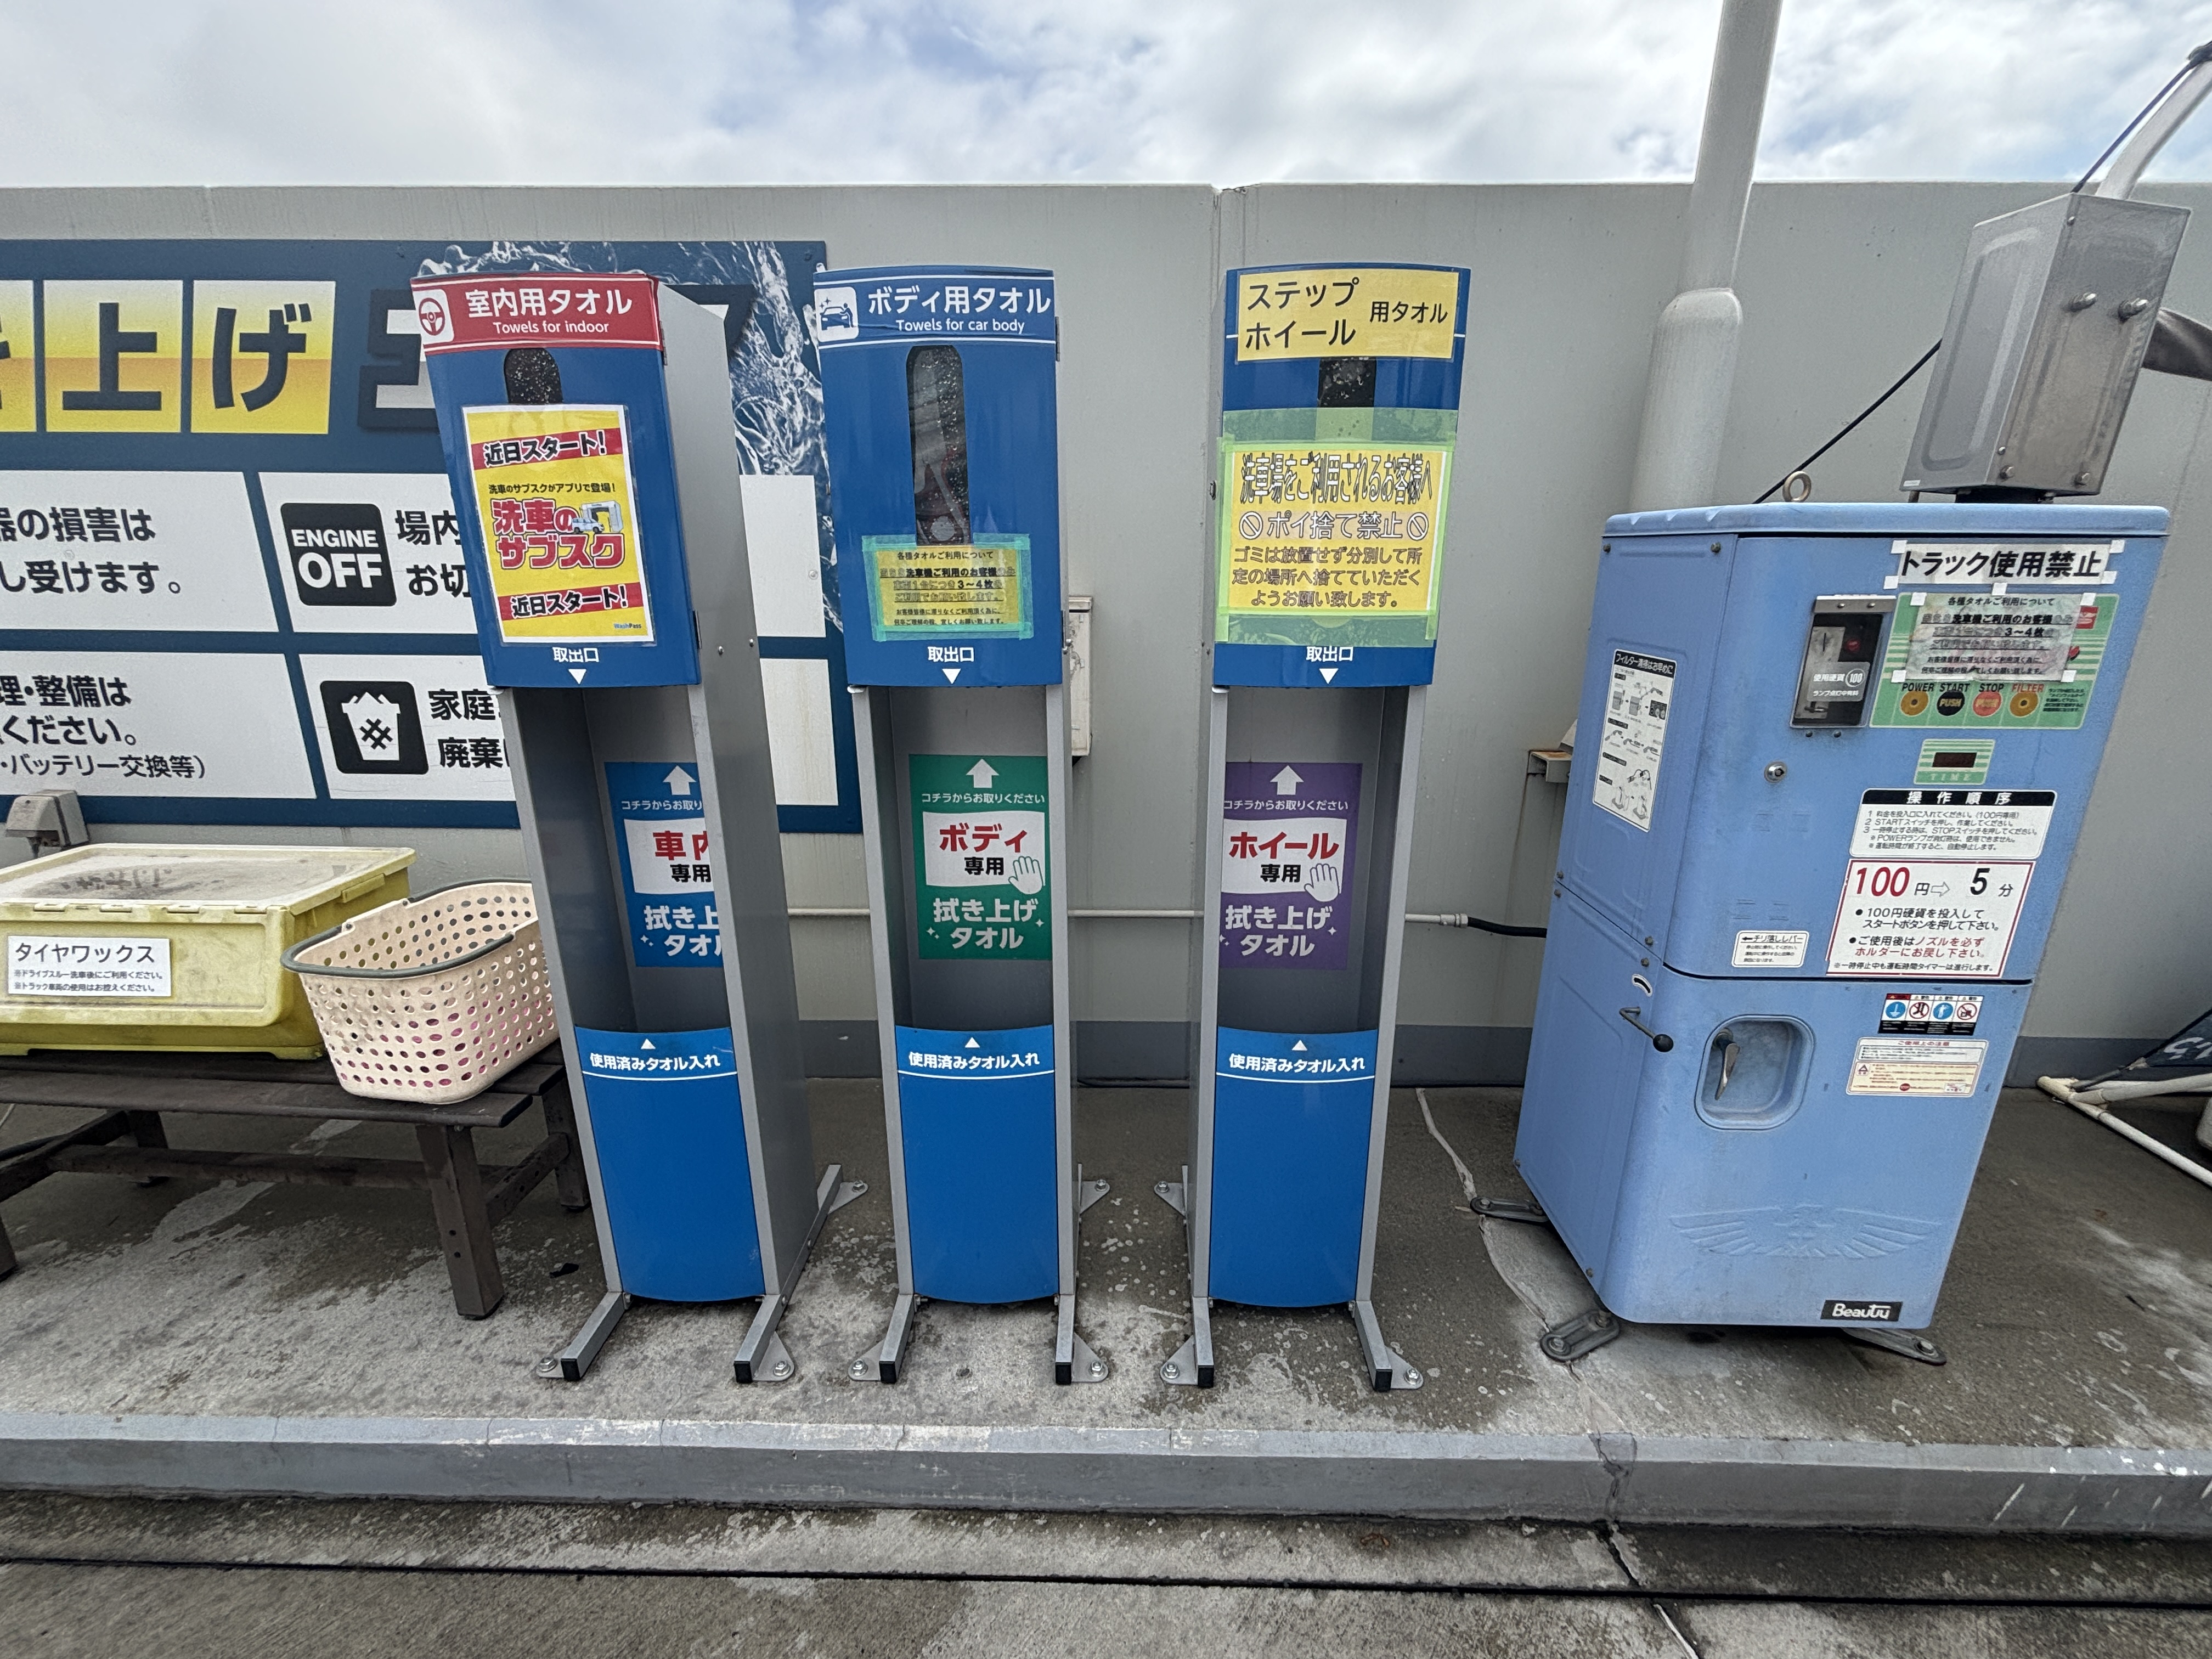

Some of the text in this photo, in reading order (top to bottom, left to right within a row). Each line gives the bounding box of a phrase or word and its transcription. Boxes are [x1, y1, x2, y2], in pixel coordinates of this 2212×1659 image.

[867, 285, 1051, 316] ボディ用タオル
[1248, 276, 1360, 311] ステップ
[465, 288, 633, 319] 室内用タオル
[1370, 300, 1448, 325] 用タオル
[493, 321, 610, 335] Towels for indoor
[896, 318, 1025, 334] Towels for car body
[1245, 318, 1356, 352] ホイール
[0, 302, 312, 411] 上げ
[484, 430, 606, 466] 近日スタート!
[1240, 451, 1433, 505] 洗車場をご利用されるお客様へ
[489, 483, 616, 494] 洗車のサブスクがアプリで登場!
[491, 498, 579, 534] 洗車の
[1267, 510, 1403, 539] ポイ捨て禁止
[291, 529, 379, 548] ENGINE
[497, 533, 624, 569] サブスク
[897, 551, 994, 560] 各種タオルご利用について
[1234, 546, 1423, 565] ゴミは放置せず分別して所
[298, 552, 382, 588] OFF
[1901, 550, 2102, 578] トラック使用禁止
[1232, 568, 1422, 586] 定の場所へ捨てていただく
[511, 585, 628, 618] 近日スタート!
[1251, 589, 1397, 608] ようお願い致します。
[1948, 597, 2056, 606] 各種タオルご利用について
[553, 646, 599, 663] 取出口
[927, 646, 975, 663] 取出口
[1306, 646, 1354, 663] 取出口
[1849, 673, 1863, 683] 100
[1901, 683, 1934, 692] POWER
[1939, 683, 1970, 692] START
[1979, 684, 2005, 692] STOP
[2012, 684, 2045, 692] FILTER
[0, 674, 132, 707] 理・整備は
[428, 689, 501, 721] 家庭
[1939, 698, 1962, 707] PUSH
[0, 714, 136, 745] ください。
[437, 736, 511, 768] 廃棄
[922, 793, 1045, 805] コチラからお取りください
[1224, 799, 1348, 811] コチラからお取りください
[1906, 791, 2012, 805] 操作順序
[939, 822, 1028, 853] ボディ
[1229, 831, 1339, 860] ホイール
[670, 864, 712, 883] 専用
[964, 857, 1004, 876] 専用
[1260, 864, 1301, 883] 専用
[933, 898, 1038, 923] 拭き上げ
[1225, 905, 1333, 930] 拭き上げ
[1867, 908, 1985, 919] 100円硬貨を投入して
[1863, 919, 1999, 931] スタートボタンを押して下さい。
[951, 926, 1024, 950] タオル
[1240, 934, 1315, 957] タオル
[1858, 936, 1984, 947] ご使用後はノズルを必ず
[15, 943, 154, 963] タイヤワックス
[1855, 947, 1984, 959] ホルダーにお戻し下さい。
[590, 1052, 720, 1071] 使用済みタオル入れ
[909, 1052, 1040, 1071] 使用済みタオル入れ
[1229, 1053, 1365, 1073] 使用済みタオル入れ
